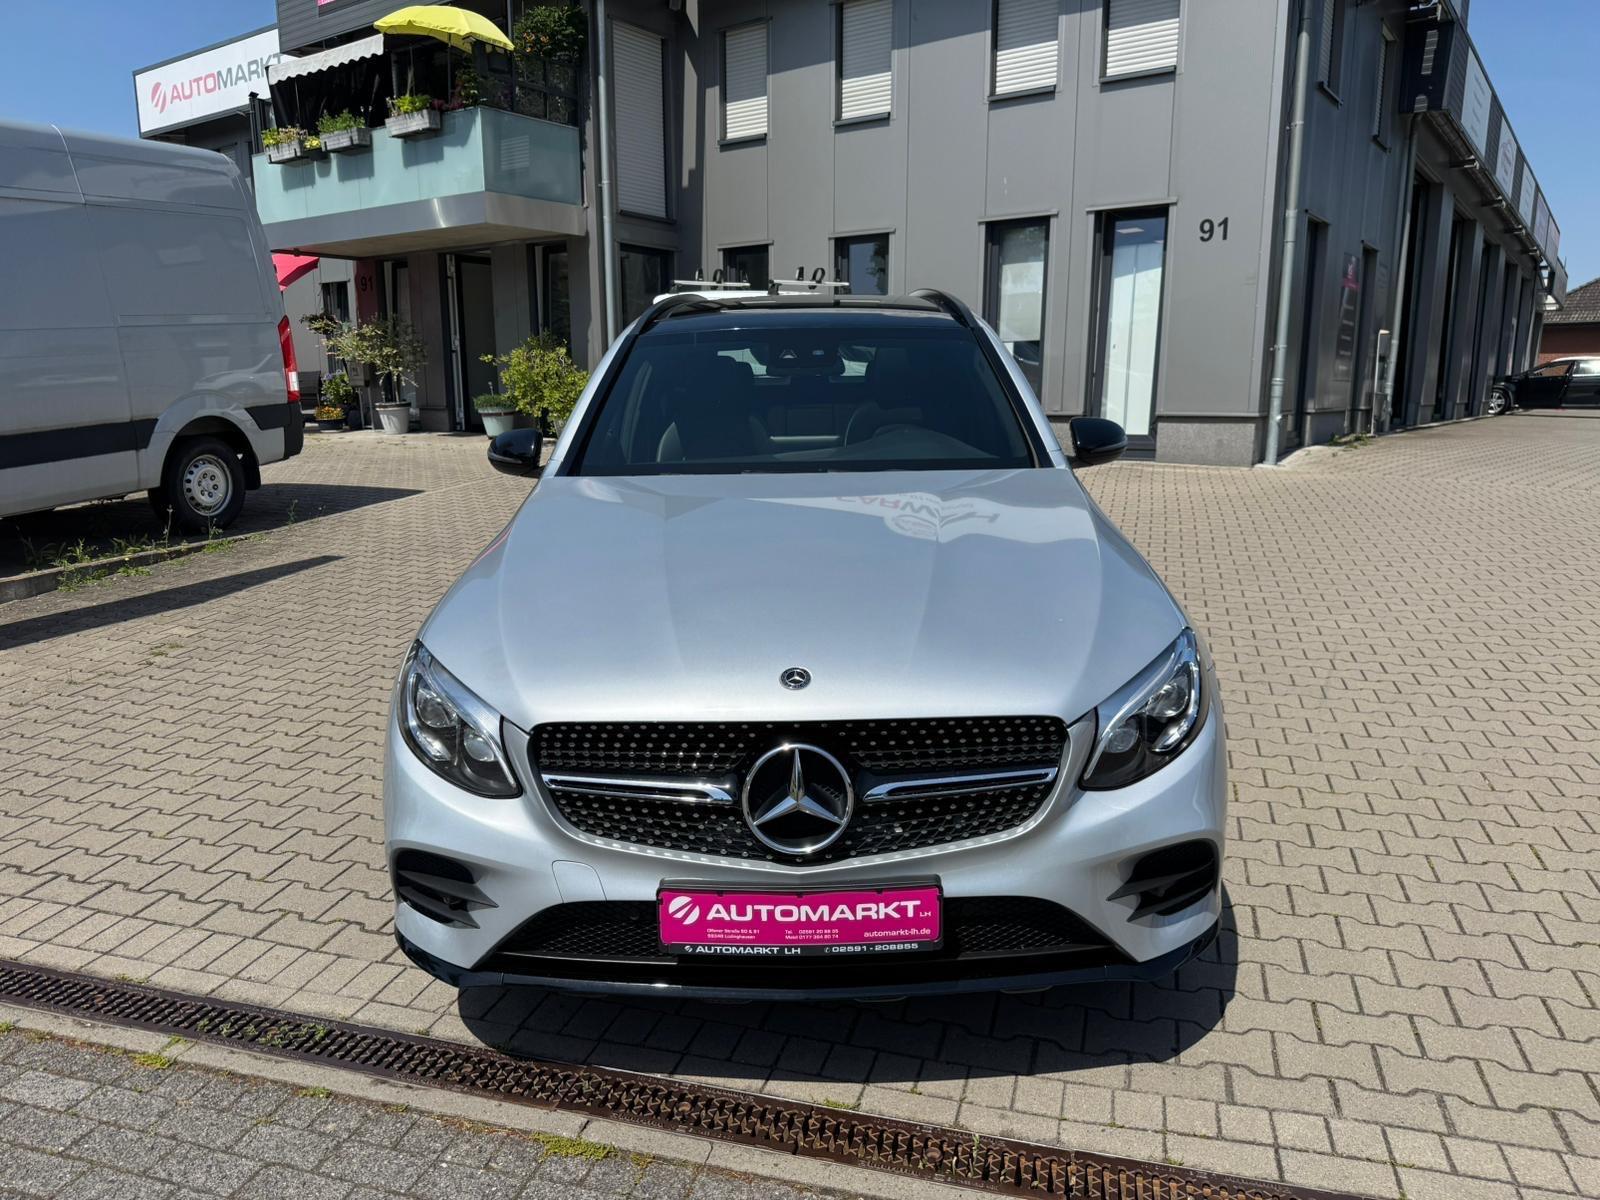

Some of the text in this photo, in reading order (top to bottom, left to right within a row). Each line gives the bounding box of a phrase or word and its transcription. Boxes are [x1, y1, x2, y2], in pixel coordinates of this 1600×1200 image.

[1199, 216, 1229, 242] 91
[360, 276, 373, 292] 91
[706, 900, 921, 922] AUTOMARKT
[863, 928, 931, 938] automarkt-lh.de
[695, 946, 800, 955] AUTOMARKT LH
